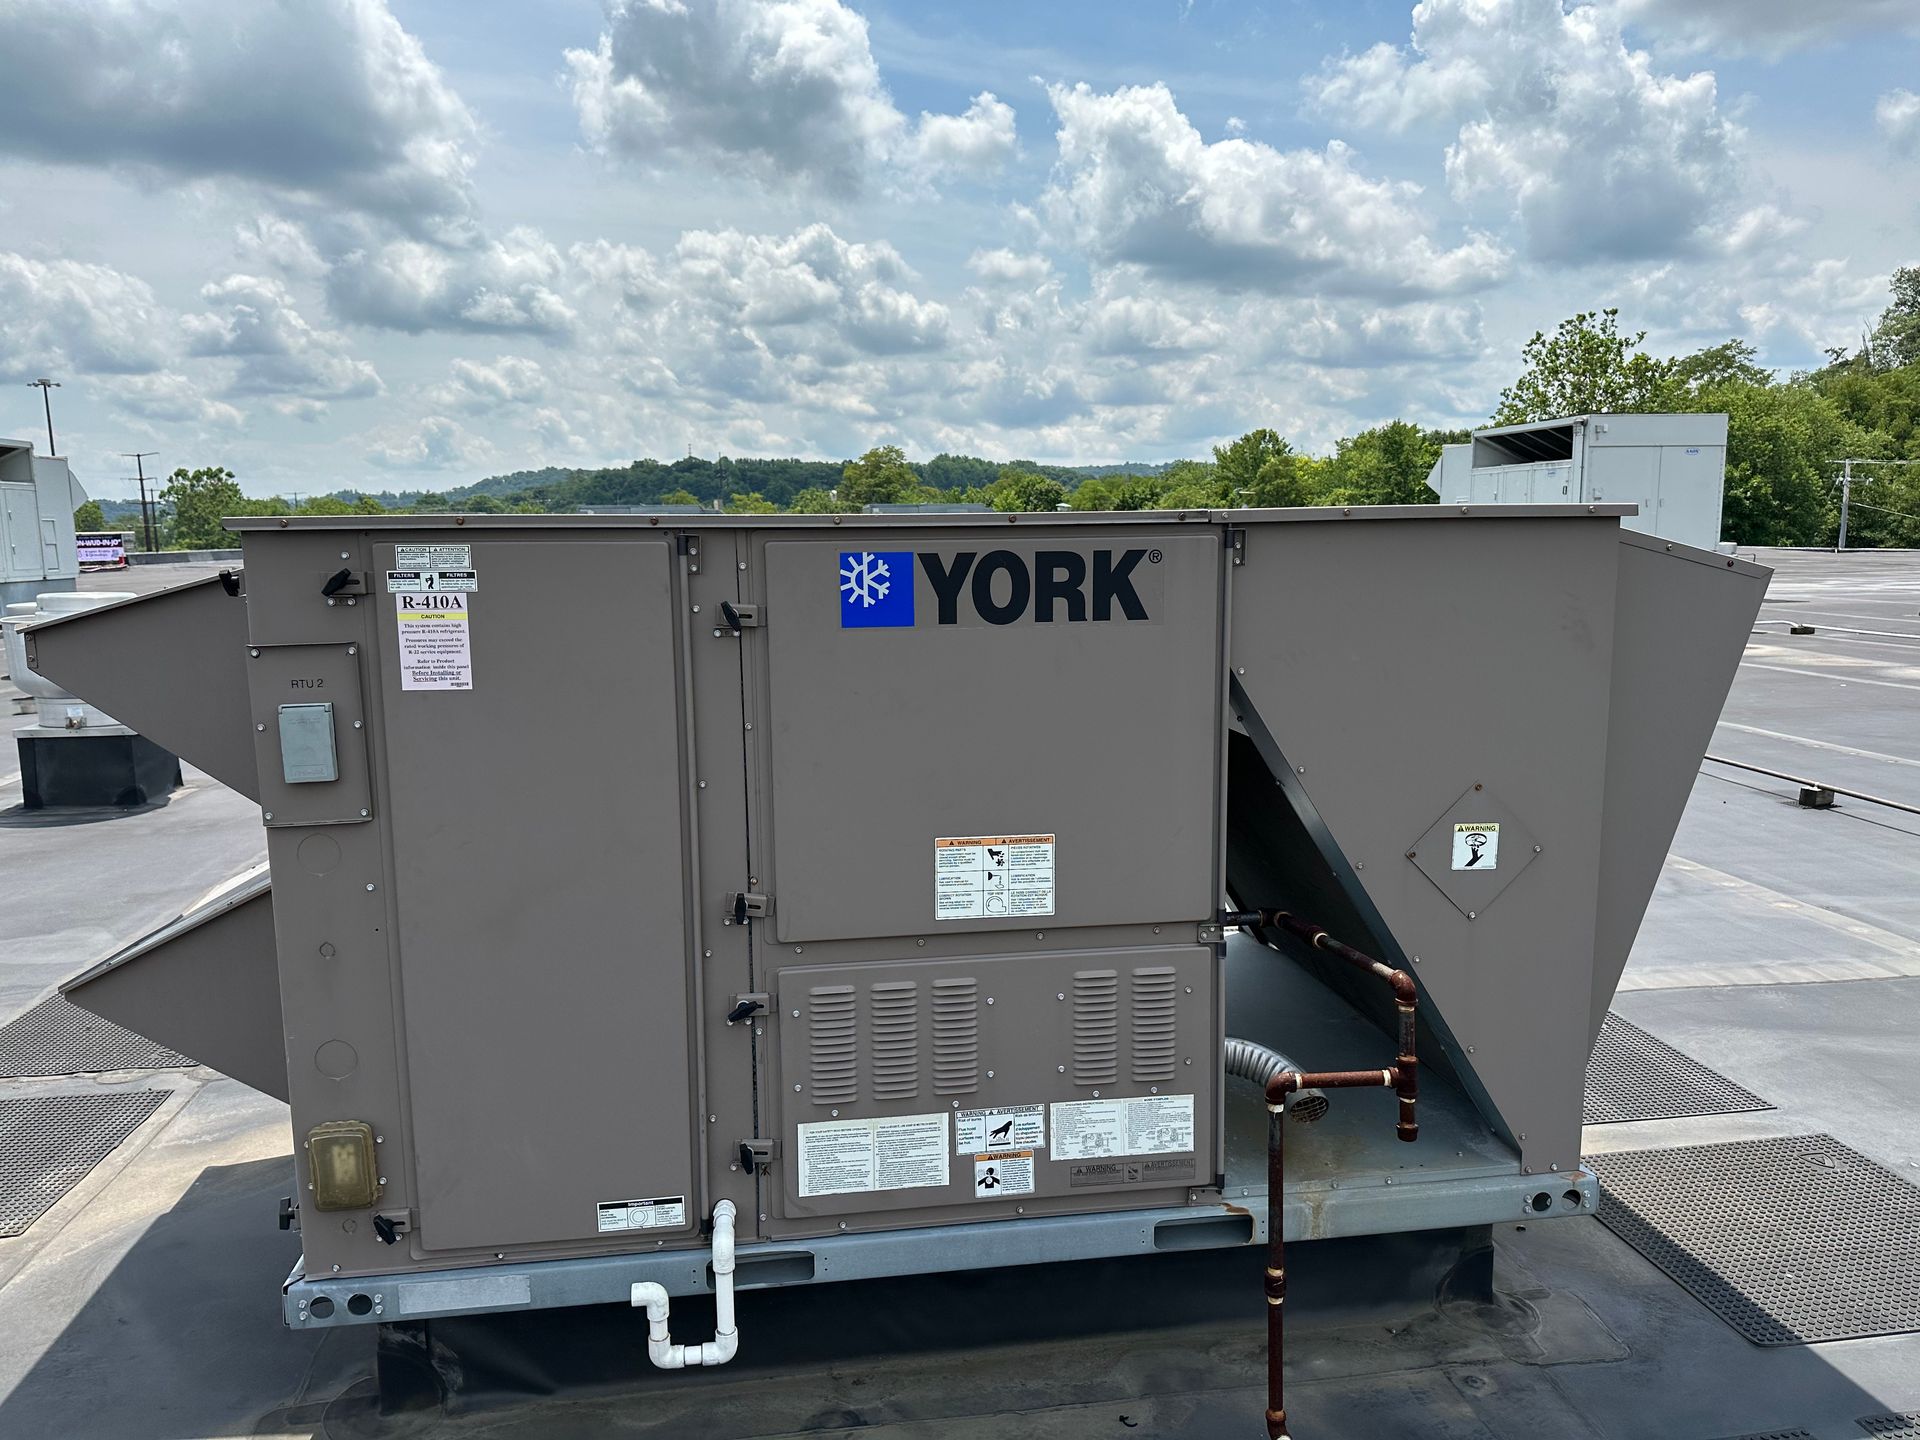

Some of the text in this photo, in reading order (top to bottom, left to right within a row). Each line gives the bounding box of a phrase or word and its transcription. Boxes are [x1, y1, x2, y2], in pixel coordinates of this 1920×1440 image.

[401, 595, 462, 609] R-410A
[291, 679, 323, 689] RTU 2
